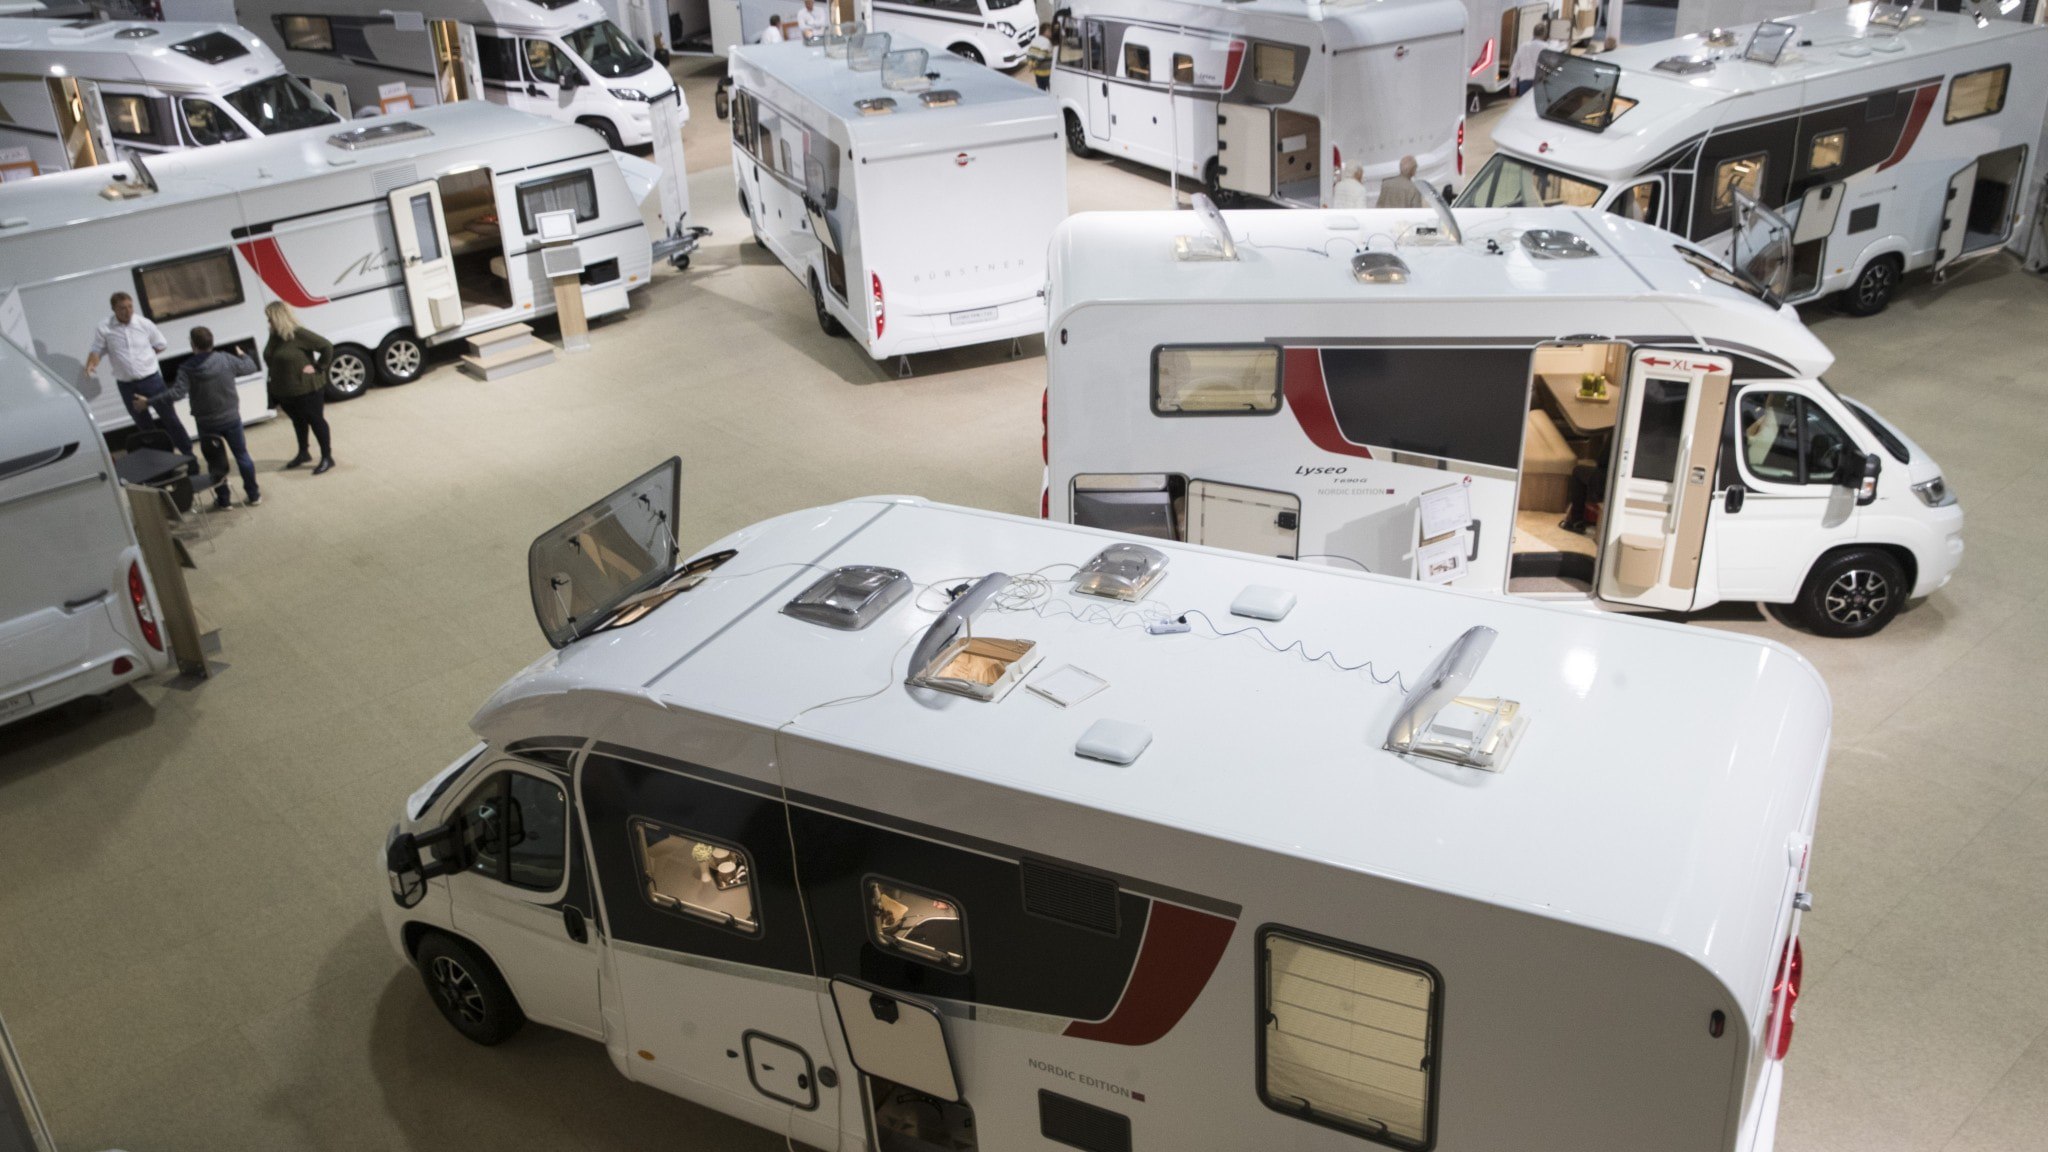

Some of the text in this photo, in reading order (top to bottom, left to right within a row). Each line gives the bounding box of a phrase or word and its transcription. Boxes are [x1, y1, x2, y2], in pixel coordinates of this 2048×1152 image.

[1673, 360, 1691, 371] XL
[1295, 465, 1347, 476] Lyseo
[1028, 1058, 1129, 1098] NORDIC EDITION
